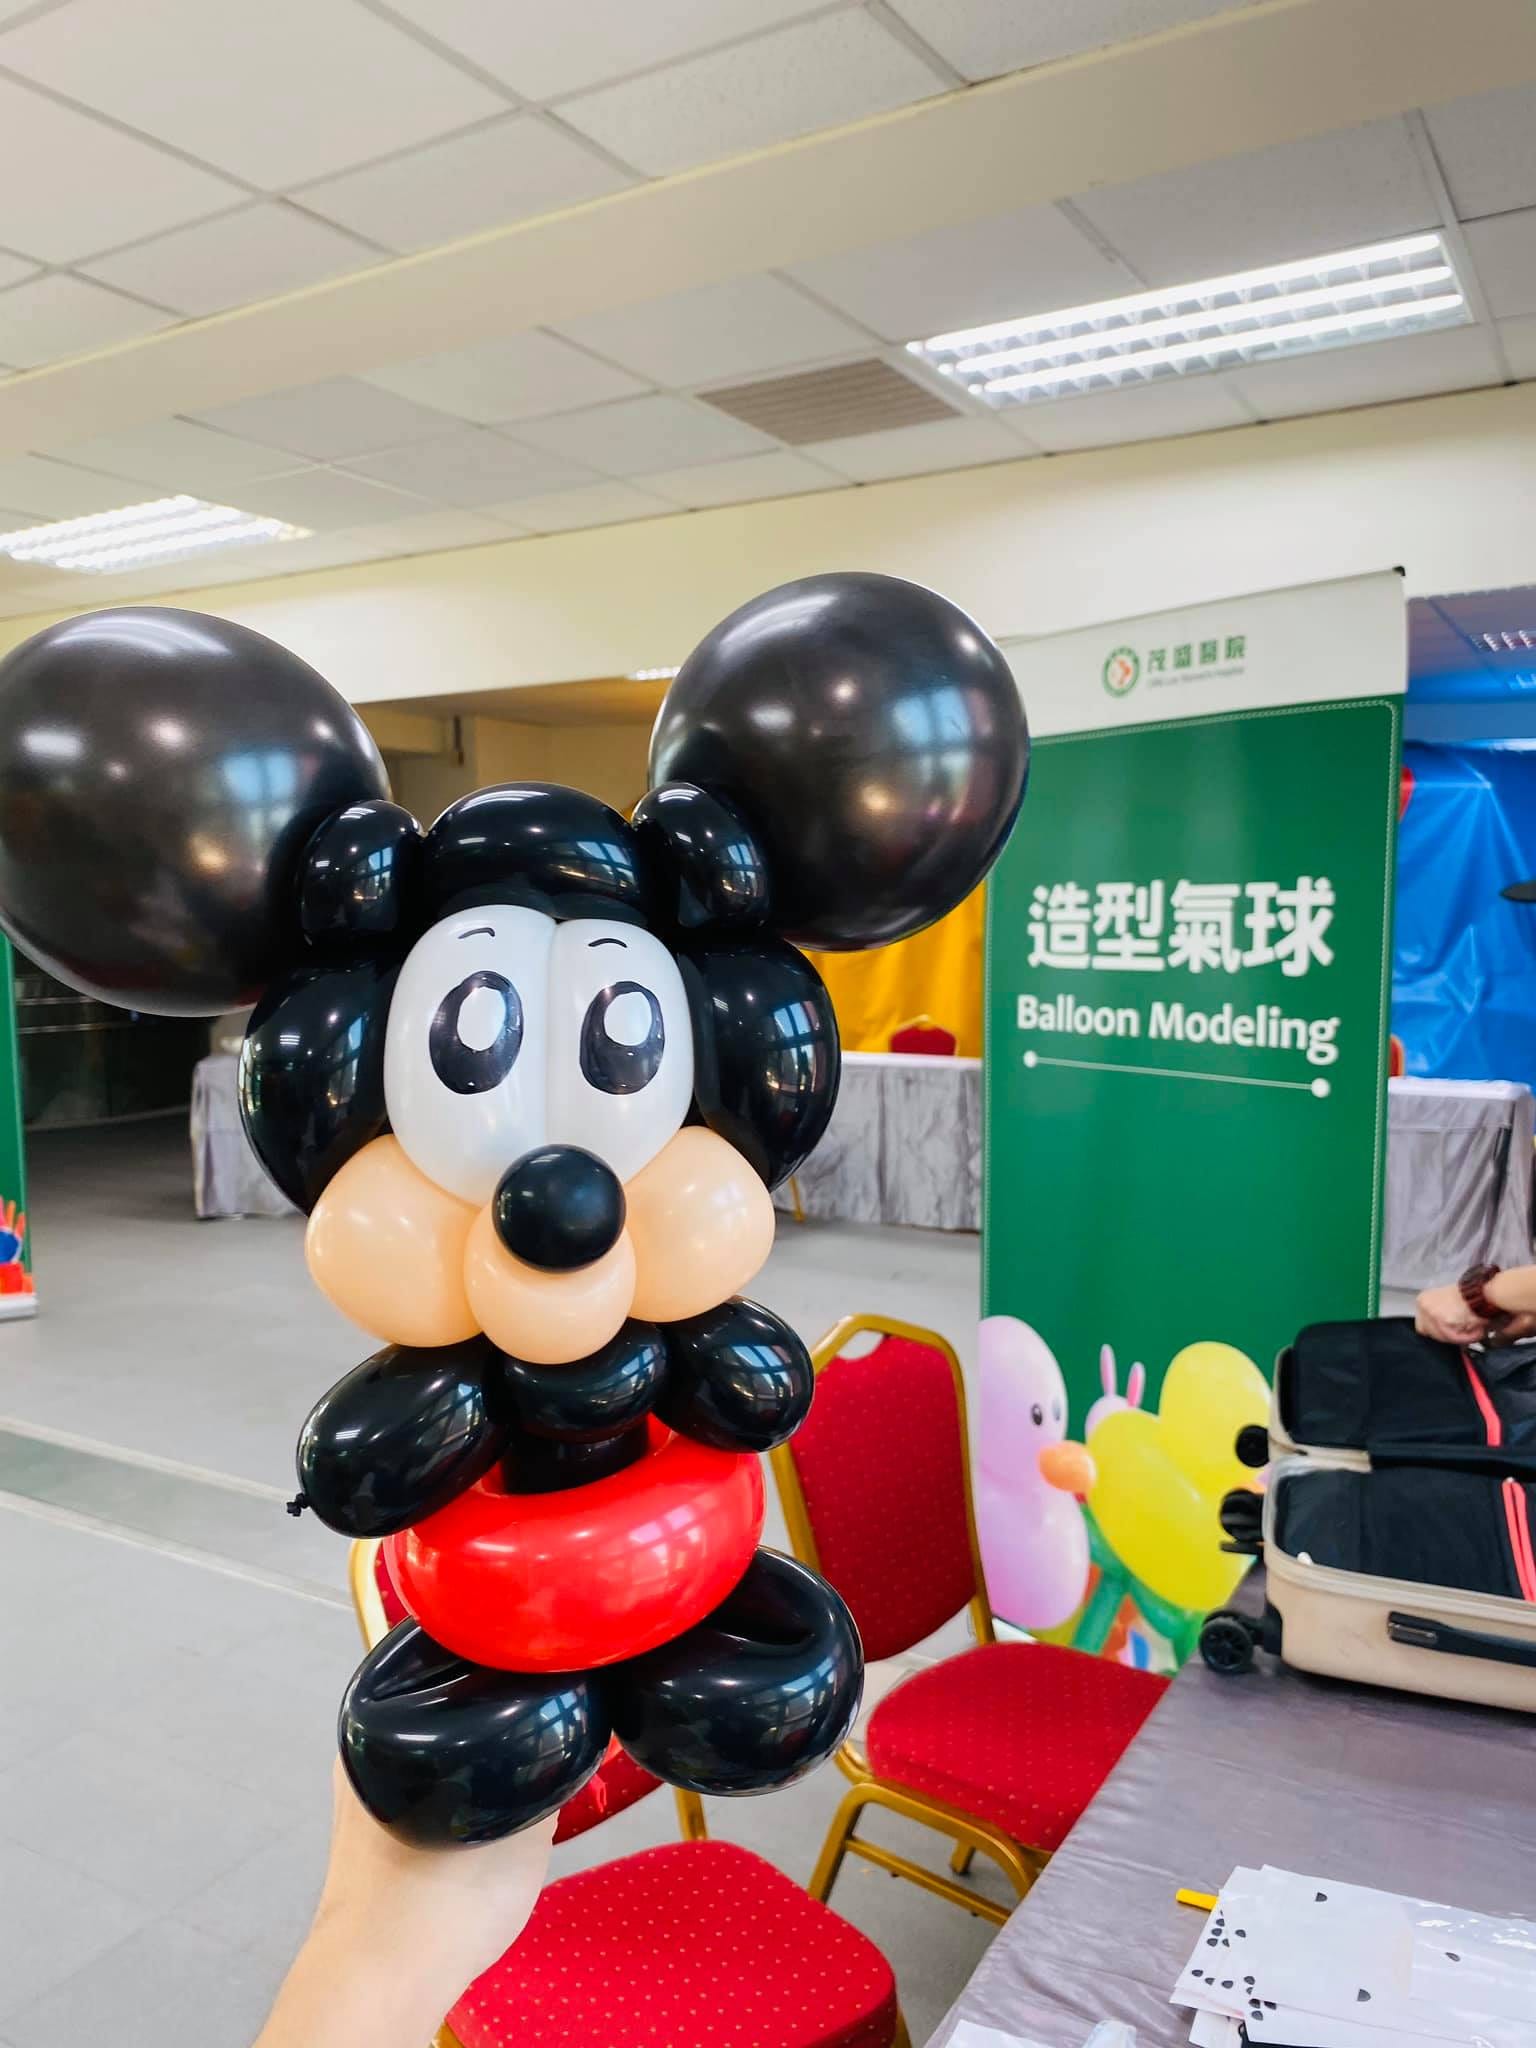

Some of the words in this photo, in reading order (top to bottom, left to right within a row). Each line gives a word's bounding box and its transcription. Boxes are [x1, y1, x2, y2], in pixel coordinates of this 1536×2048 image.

[1027, 875, 1335, 977] 造型氣球
[1016, 993, 1140, 1038] Balloon
[1148, 1001, 1340, 1066] Modeling
